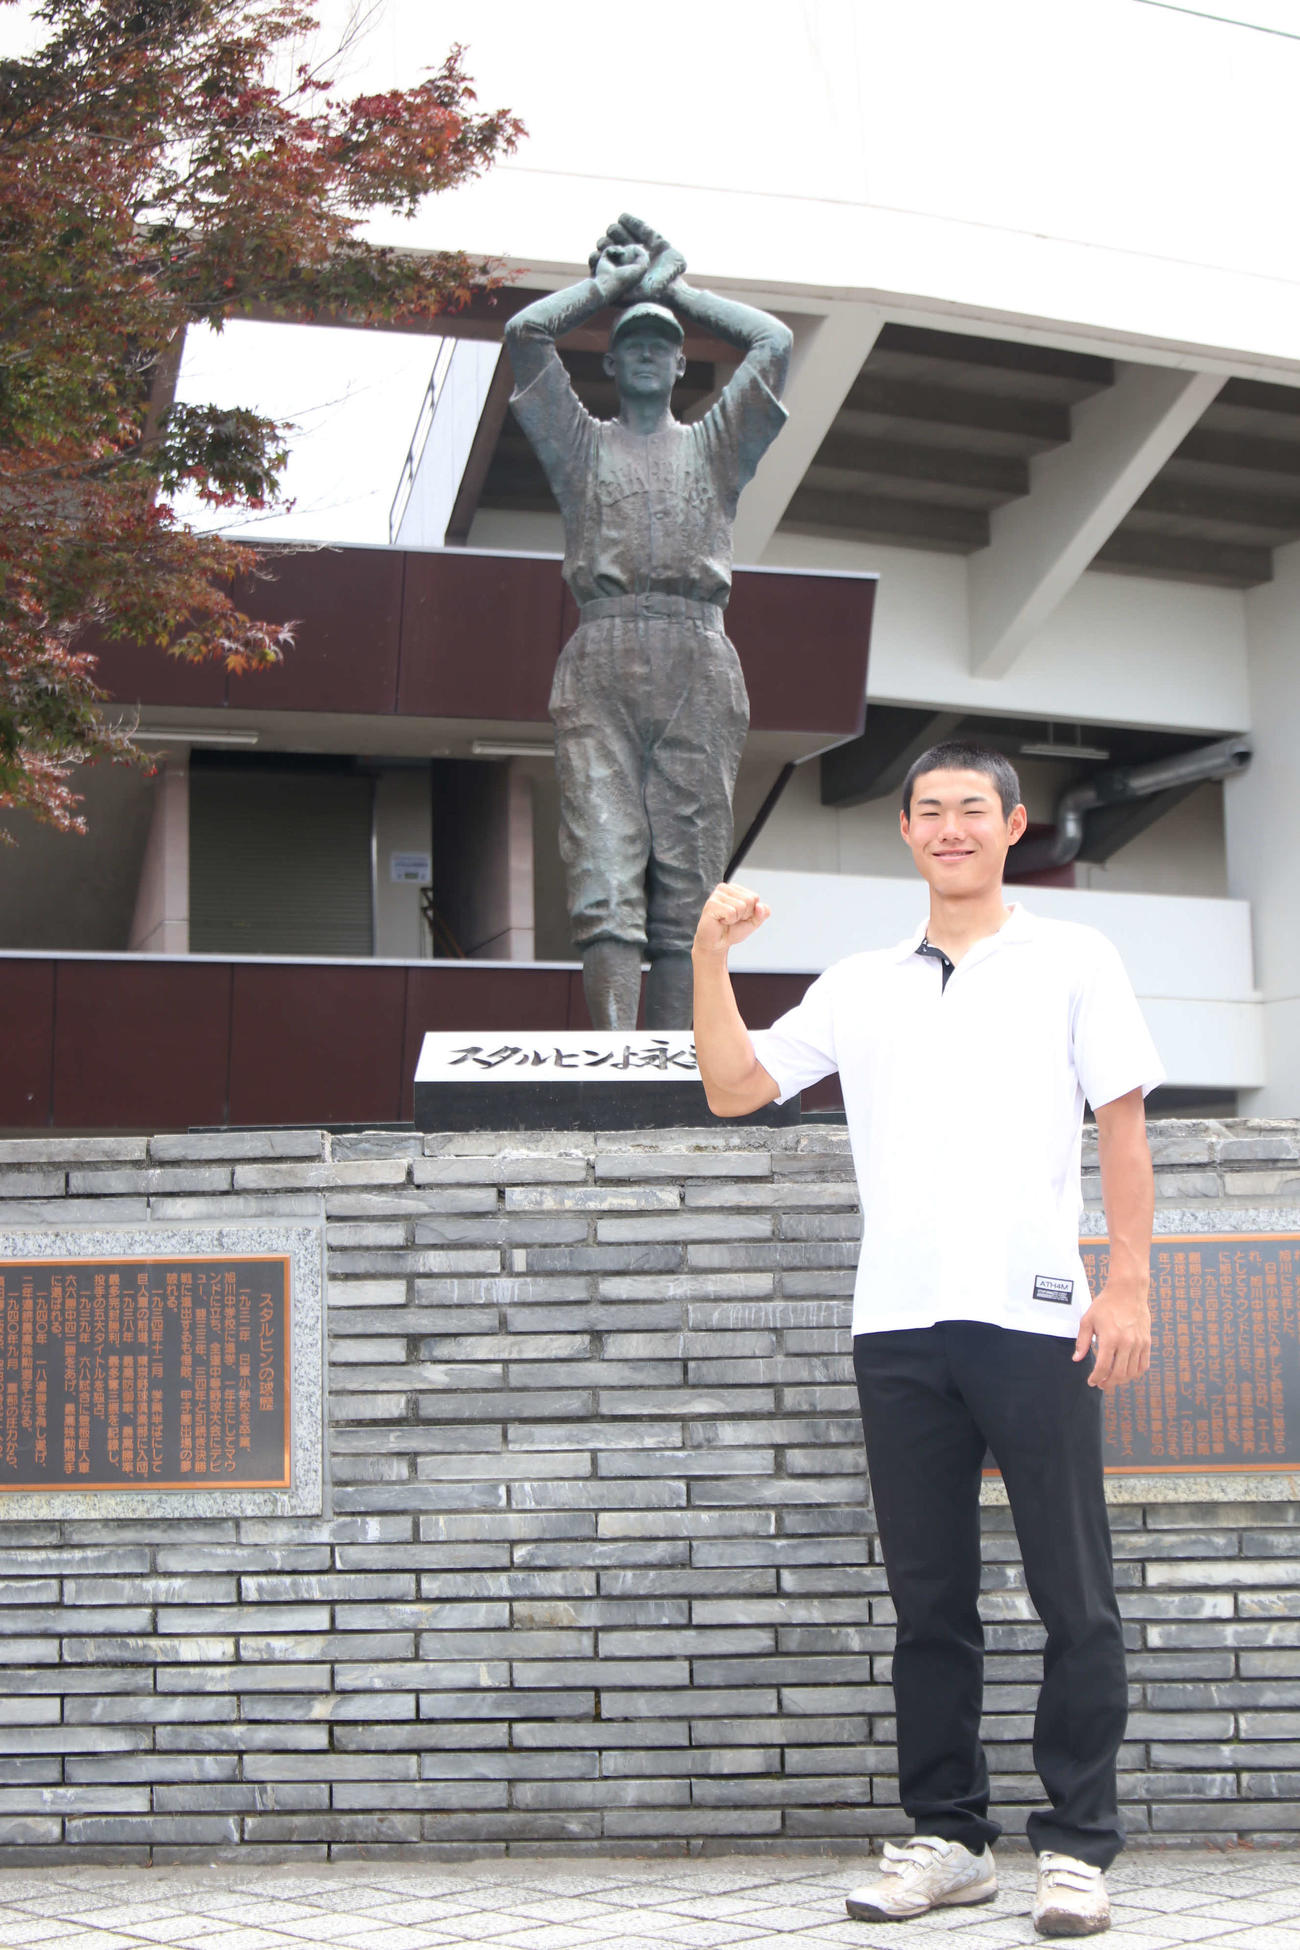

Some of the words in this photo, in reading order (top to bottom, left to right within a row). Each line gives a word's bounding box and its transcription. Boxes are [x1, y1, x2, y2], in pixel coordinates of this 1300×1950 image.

[447, 1039, 699, 1070] スタルヒンよ永
[259, 1293, 274, 1412] スタルヒンの球歴
